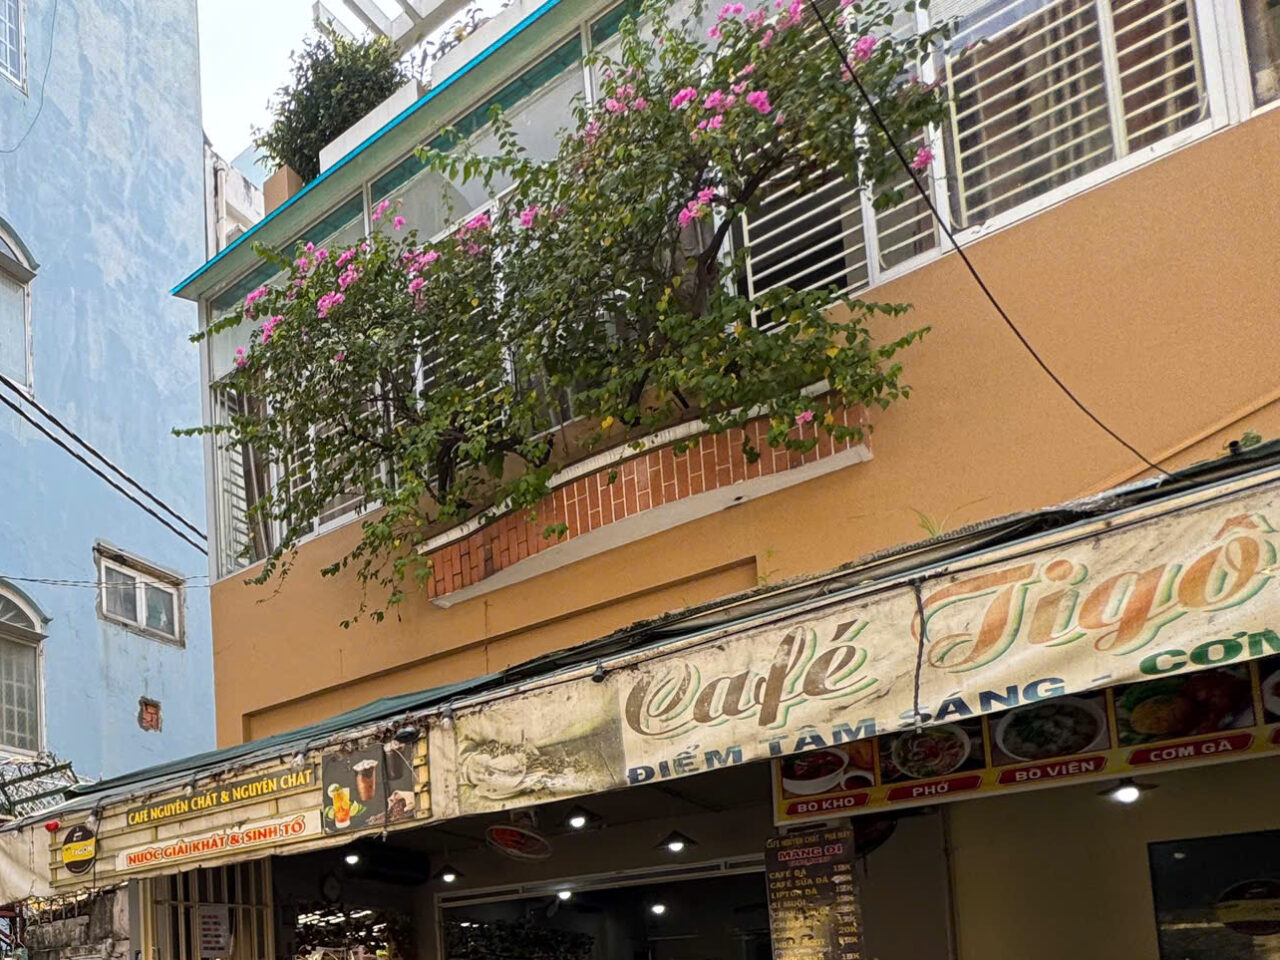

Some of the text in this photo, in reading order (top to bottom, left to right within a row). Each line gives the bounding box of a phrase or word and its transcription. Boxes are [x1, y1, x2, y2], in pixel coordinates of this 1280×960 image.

[625, 618, 878, 740] Café
[898, 676, 1066, 726] SÁNG
[912, 782, 950, 798] PHỞ
[150, 799, 188, 821] NGUYÊN
[220, 791, 230, 804] &
[822, 796, 855, 810] KHO
[228, 835, 241, 846] &
[245, 825, 279, 843] SINH
